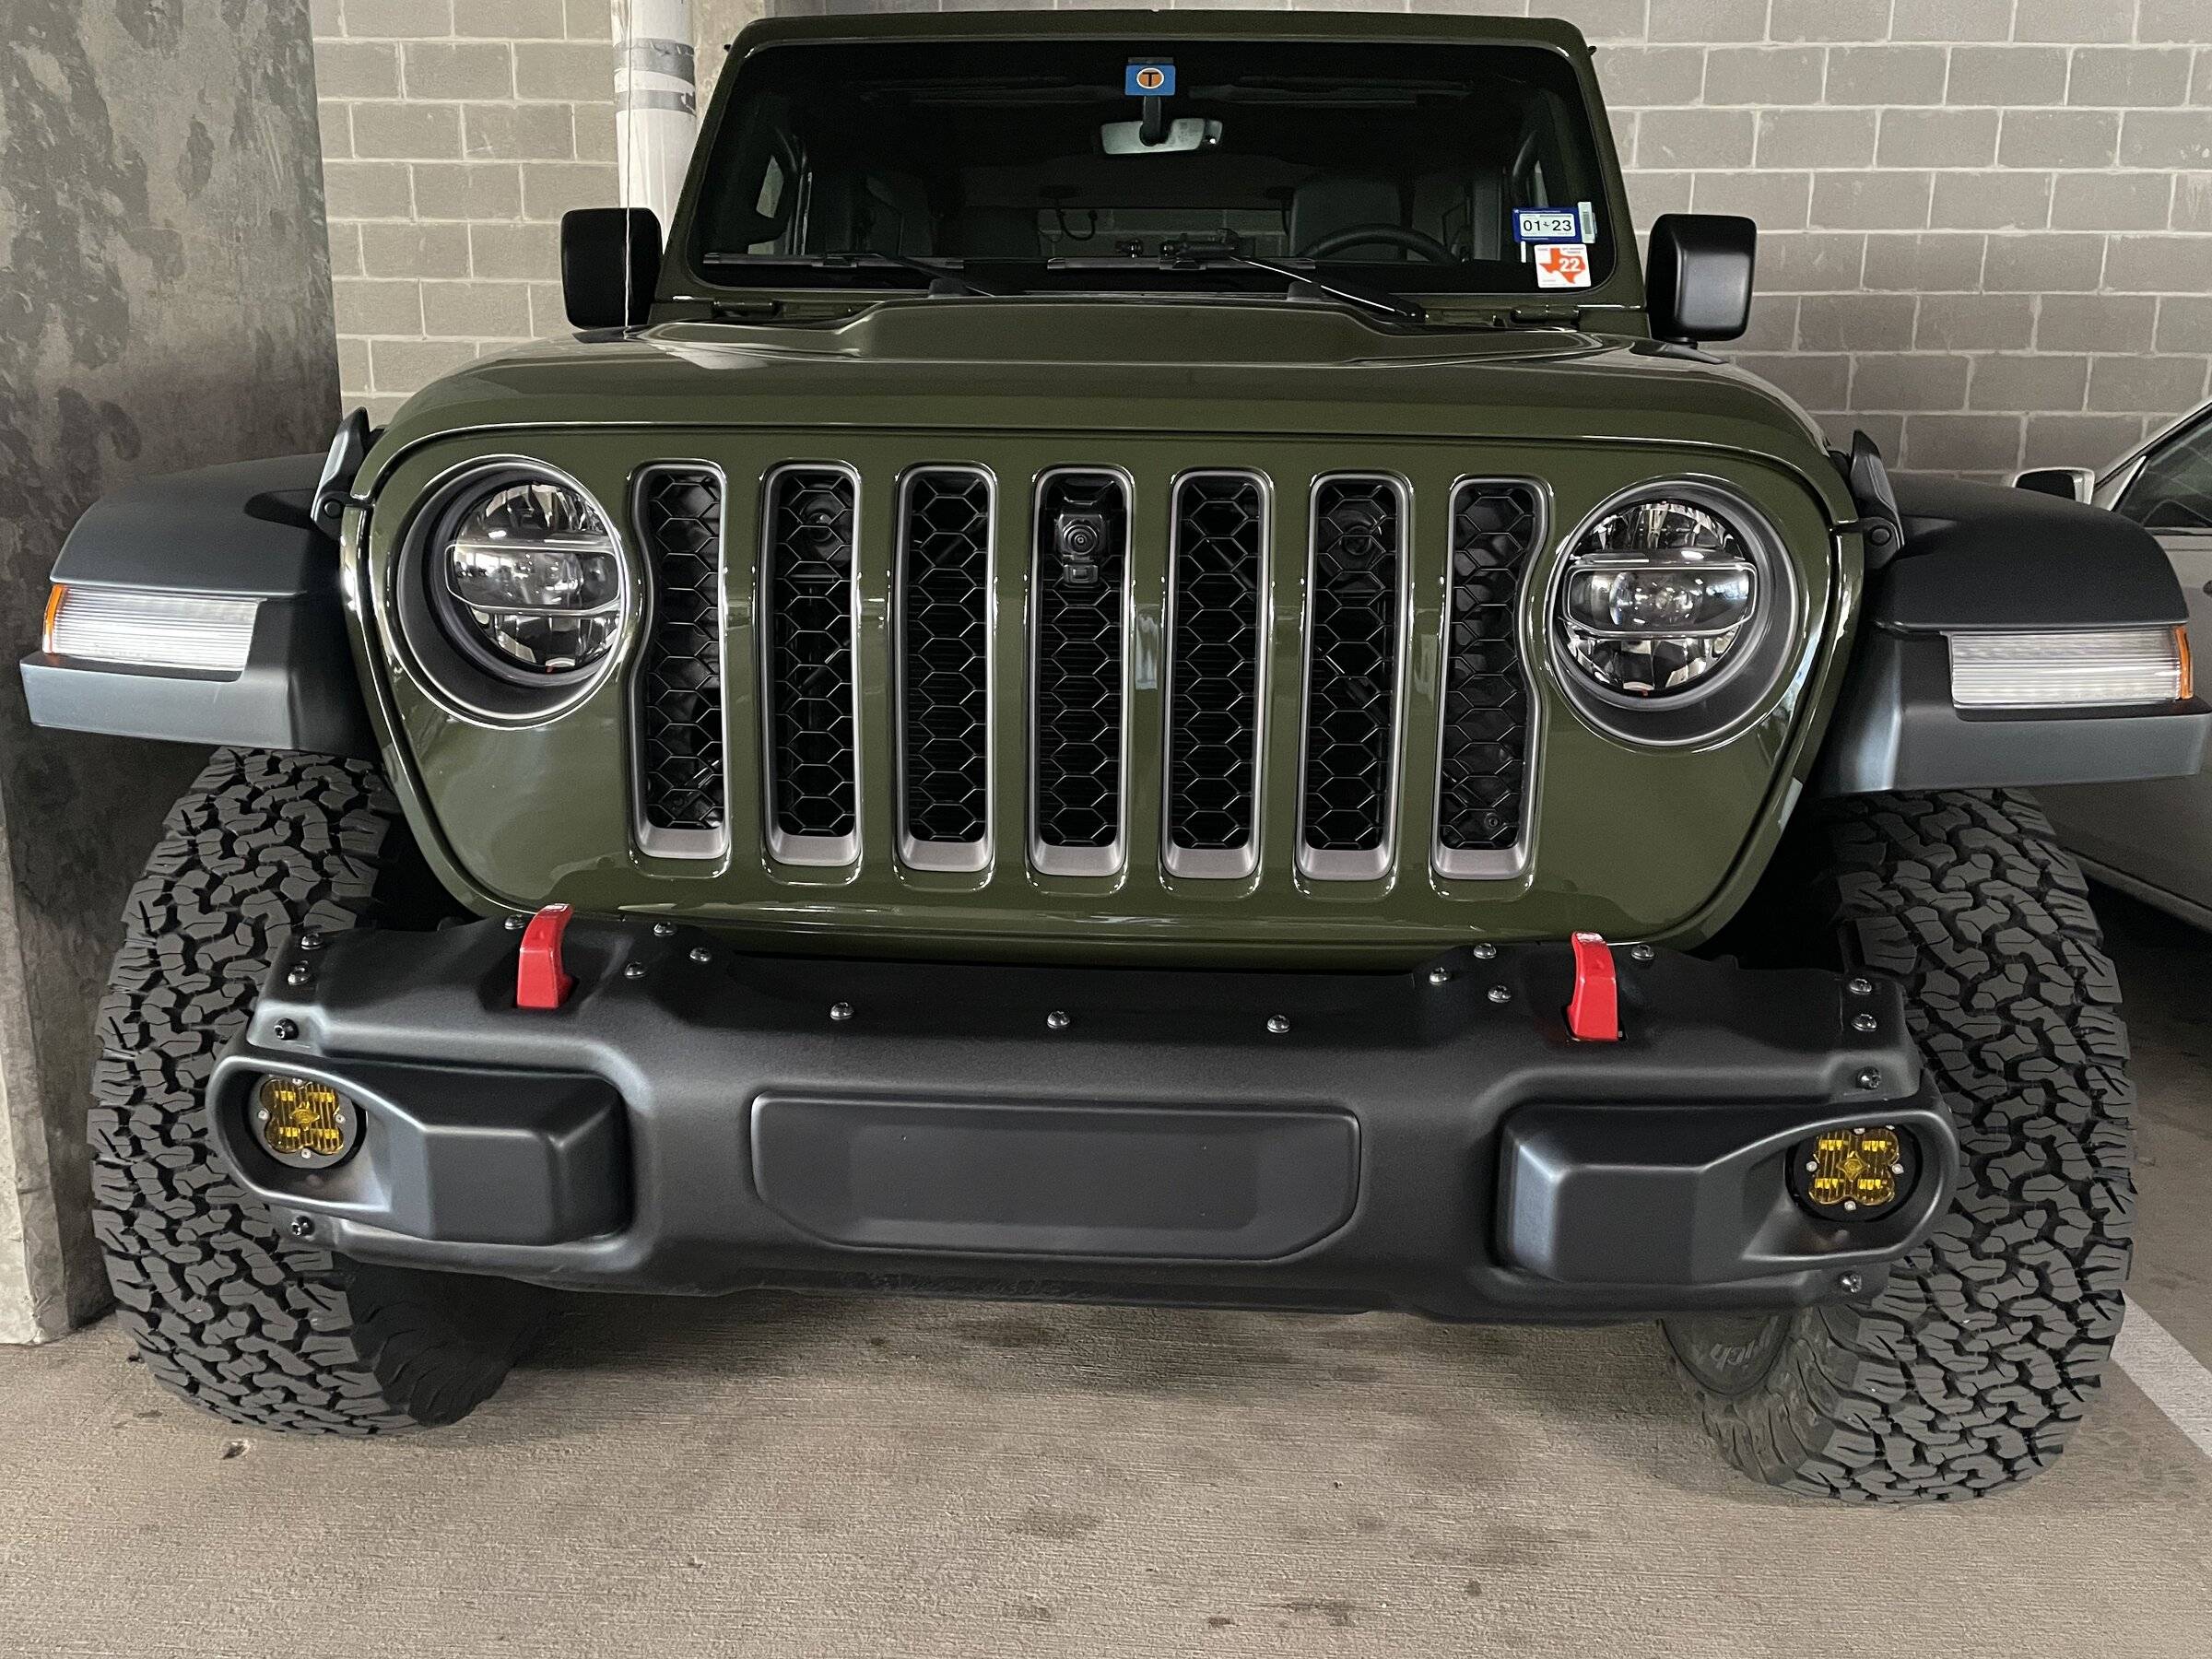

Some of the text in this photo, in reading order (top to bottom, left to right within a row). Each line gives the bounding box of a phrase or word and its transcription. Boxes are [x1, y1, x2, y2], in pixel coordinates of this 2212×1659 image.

[1142, 71, 1159, 87] T
[1523, 220, 1571, 231] 01 23
[1559, 257, 1582, 272] 22
